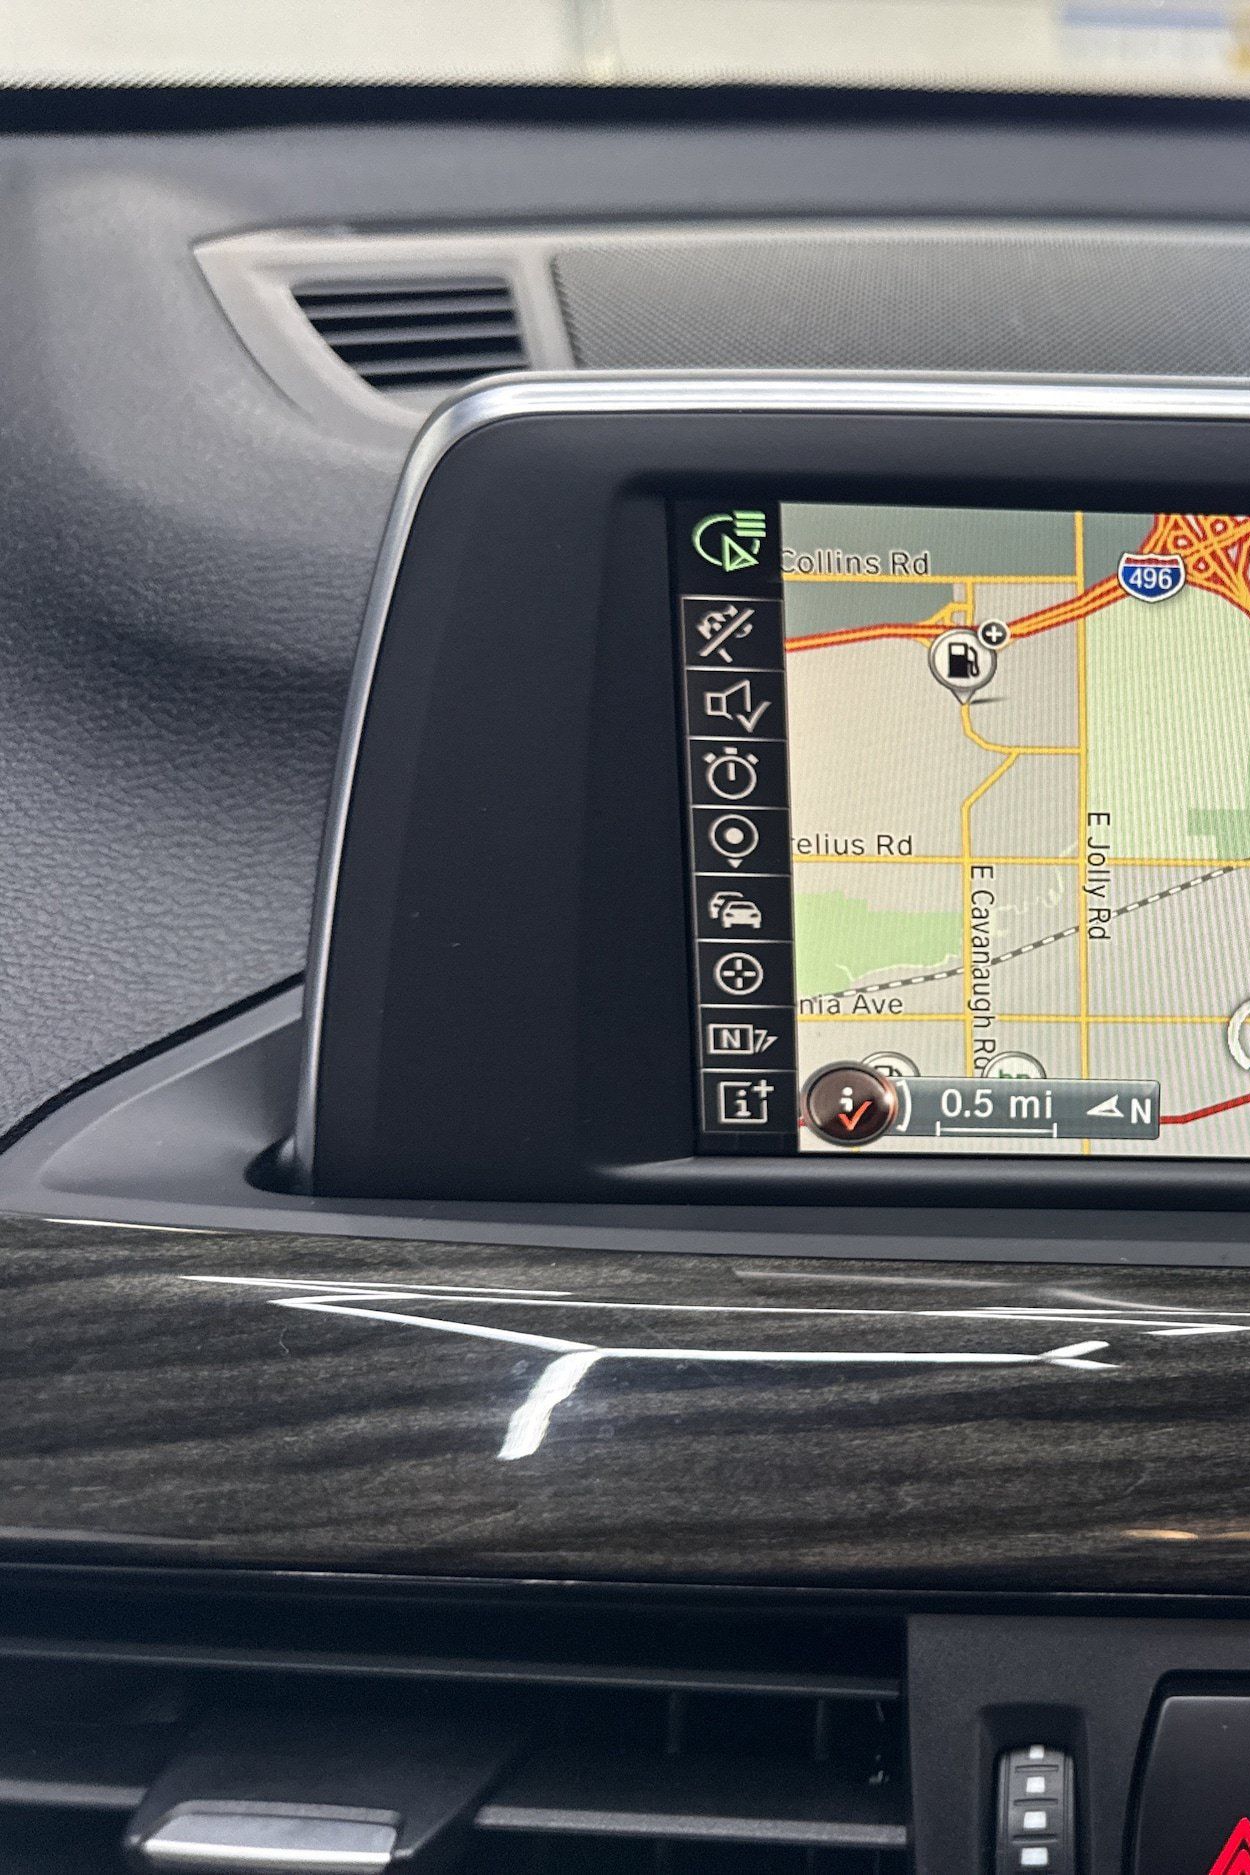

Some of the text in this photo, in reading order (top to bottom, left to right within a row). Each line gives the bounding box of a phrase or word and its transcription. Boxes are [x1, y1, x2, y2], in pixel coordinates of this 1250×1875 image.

[781, 550, 929, 575] Collins Rd
[1128, 567, 1173, 590] 496
[791, 833, 913, 856] elius Rd
[970, 865, 994, 880] E
[1082, 812, 1111, 940] E Jolly Rd
[967, 889, 996, 1029] Cavanaugh
[851, 994, 904, 1015] Ave
[940, 1088, 1053, 1119] 0.5 mi
[1130, 1097, 1152, 1125] N
